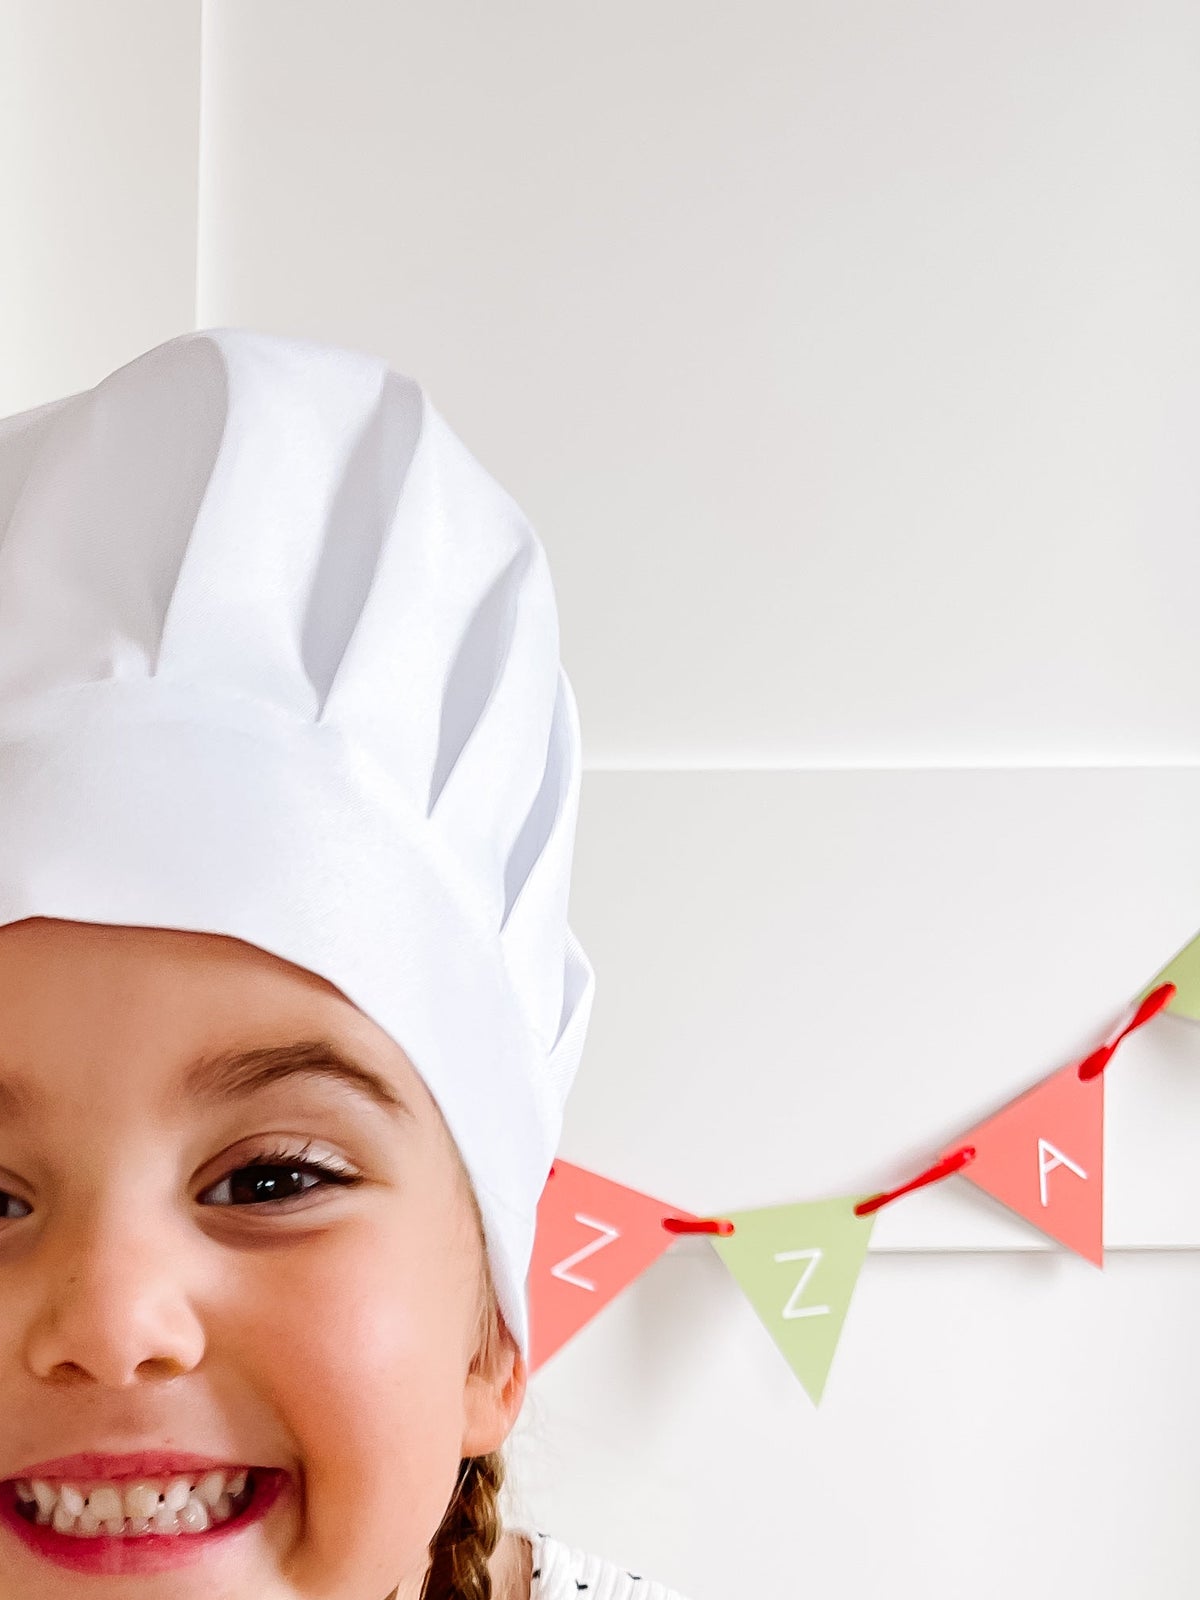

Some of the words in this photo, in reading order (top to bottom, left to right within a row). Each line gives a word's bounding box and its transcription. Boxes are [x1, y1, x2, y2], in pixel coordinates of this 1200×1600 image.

[551, 1213, 618, 1292] Z
[774, 1246, 831, 1320] Z
[1037, 1137, 1088, 1207] A
